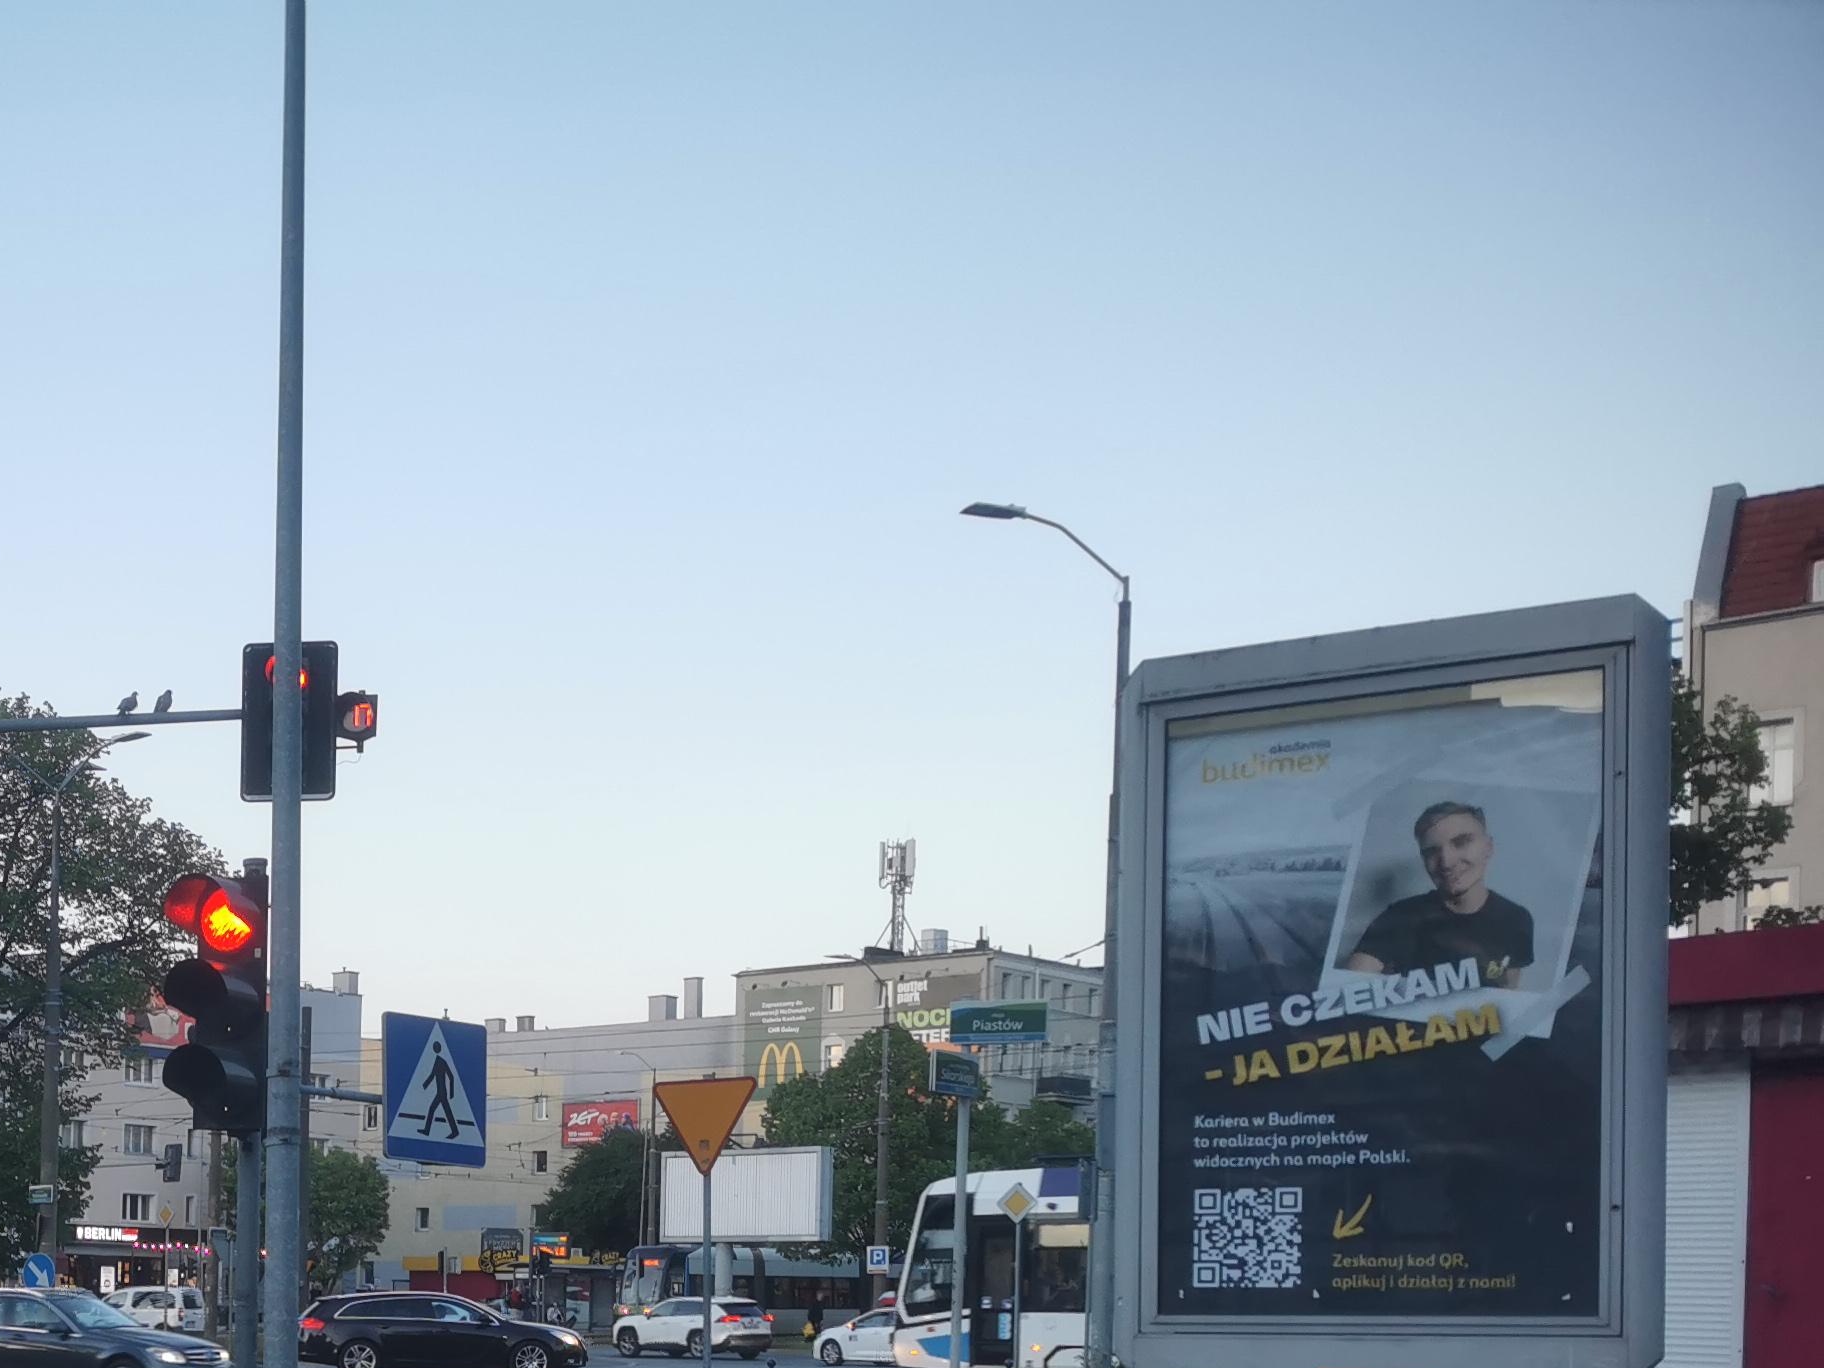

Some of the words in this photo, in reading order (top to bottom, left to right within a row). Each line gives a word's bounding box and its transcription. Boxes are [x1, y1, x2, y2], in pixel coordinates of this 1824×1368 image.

[897, 979, 928, 994] outlet
[897, 991, 920, 1005] park
[1197, 1002, 1272, 1045] NIE
[1280, 957, 1480, 1026] CZEKAM
[972, 1018, 1024, 1031] Piastów
[1233, 1049, 1281, 1086] JA
[1287, 1001, 1501, 1074] DZIAŁAM
[1194, 1115, 1249, 1129] Kariera
[1251, 1117, 1265, 1127] w
[1268, 1112, 1336, 1127] Budimex
[1194, 1136, 1210, 1148] to
[1212, 1133, 1288, 1149] realizacja
[1291, 1130, 1369, 1148] projektów
[1193, 1153, 1280, 1169] widocznych
[1284, 1154, 1304, 1166] na
[1307, 1151, 1356, 1168] mapie
[1359, 1149, 1411, 1165] Polski.
[84, 1227, 122, 1241] BERLIN
[1332, 1254, 1403, 1270] Zeskanuj
[1407, 1254, 1436, 1268] kod
[1439, 1253, 1469, 1269] QR,
[1332, 1275, 1387, 1292] aplikuj
[1398, 1274, 1454, 1292] działaj
[1457, 1278, 1466, 1289] z
[1469, 1275, 1516, 1289] nami!
